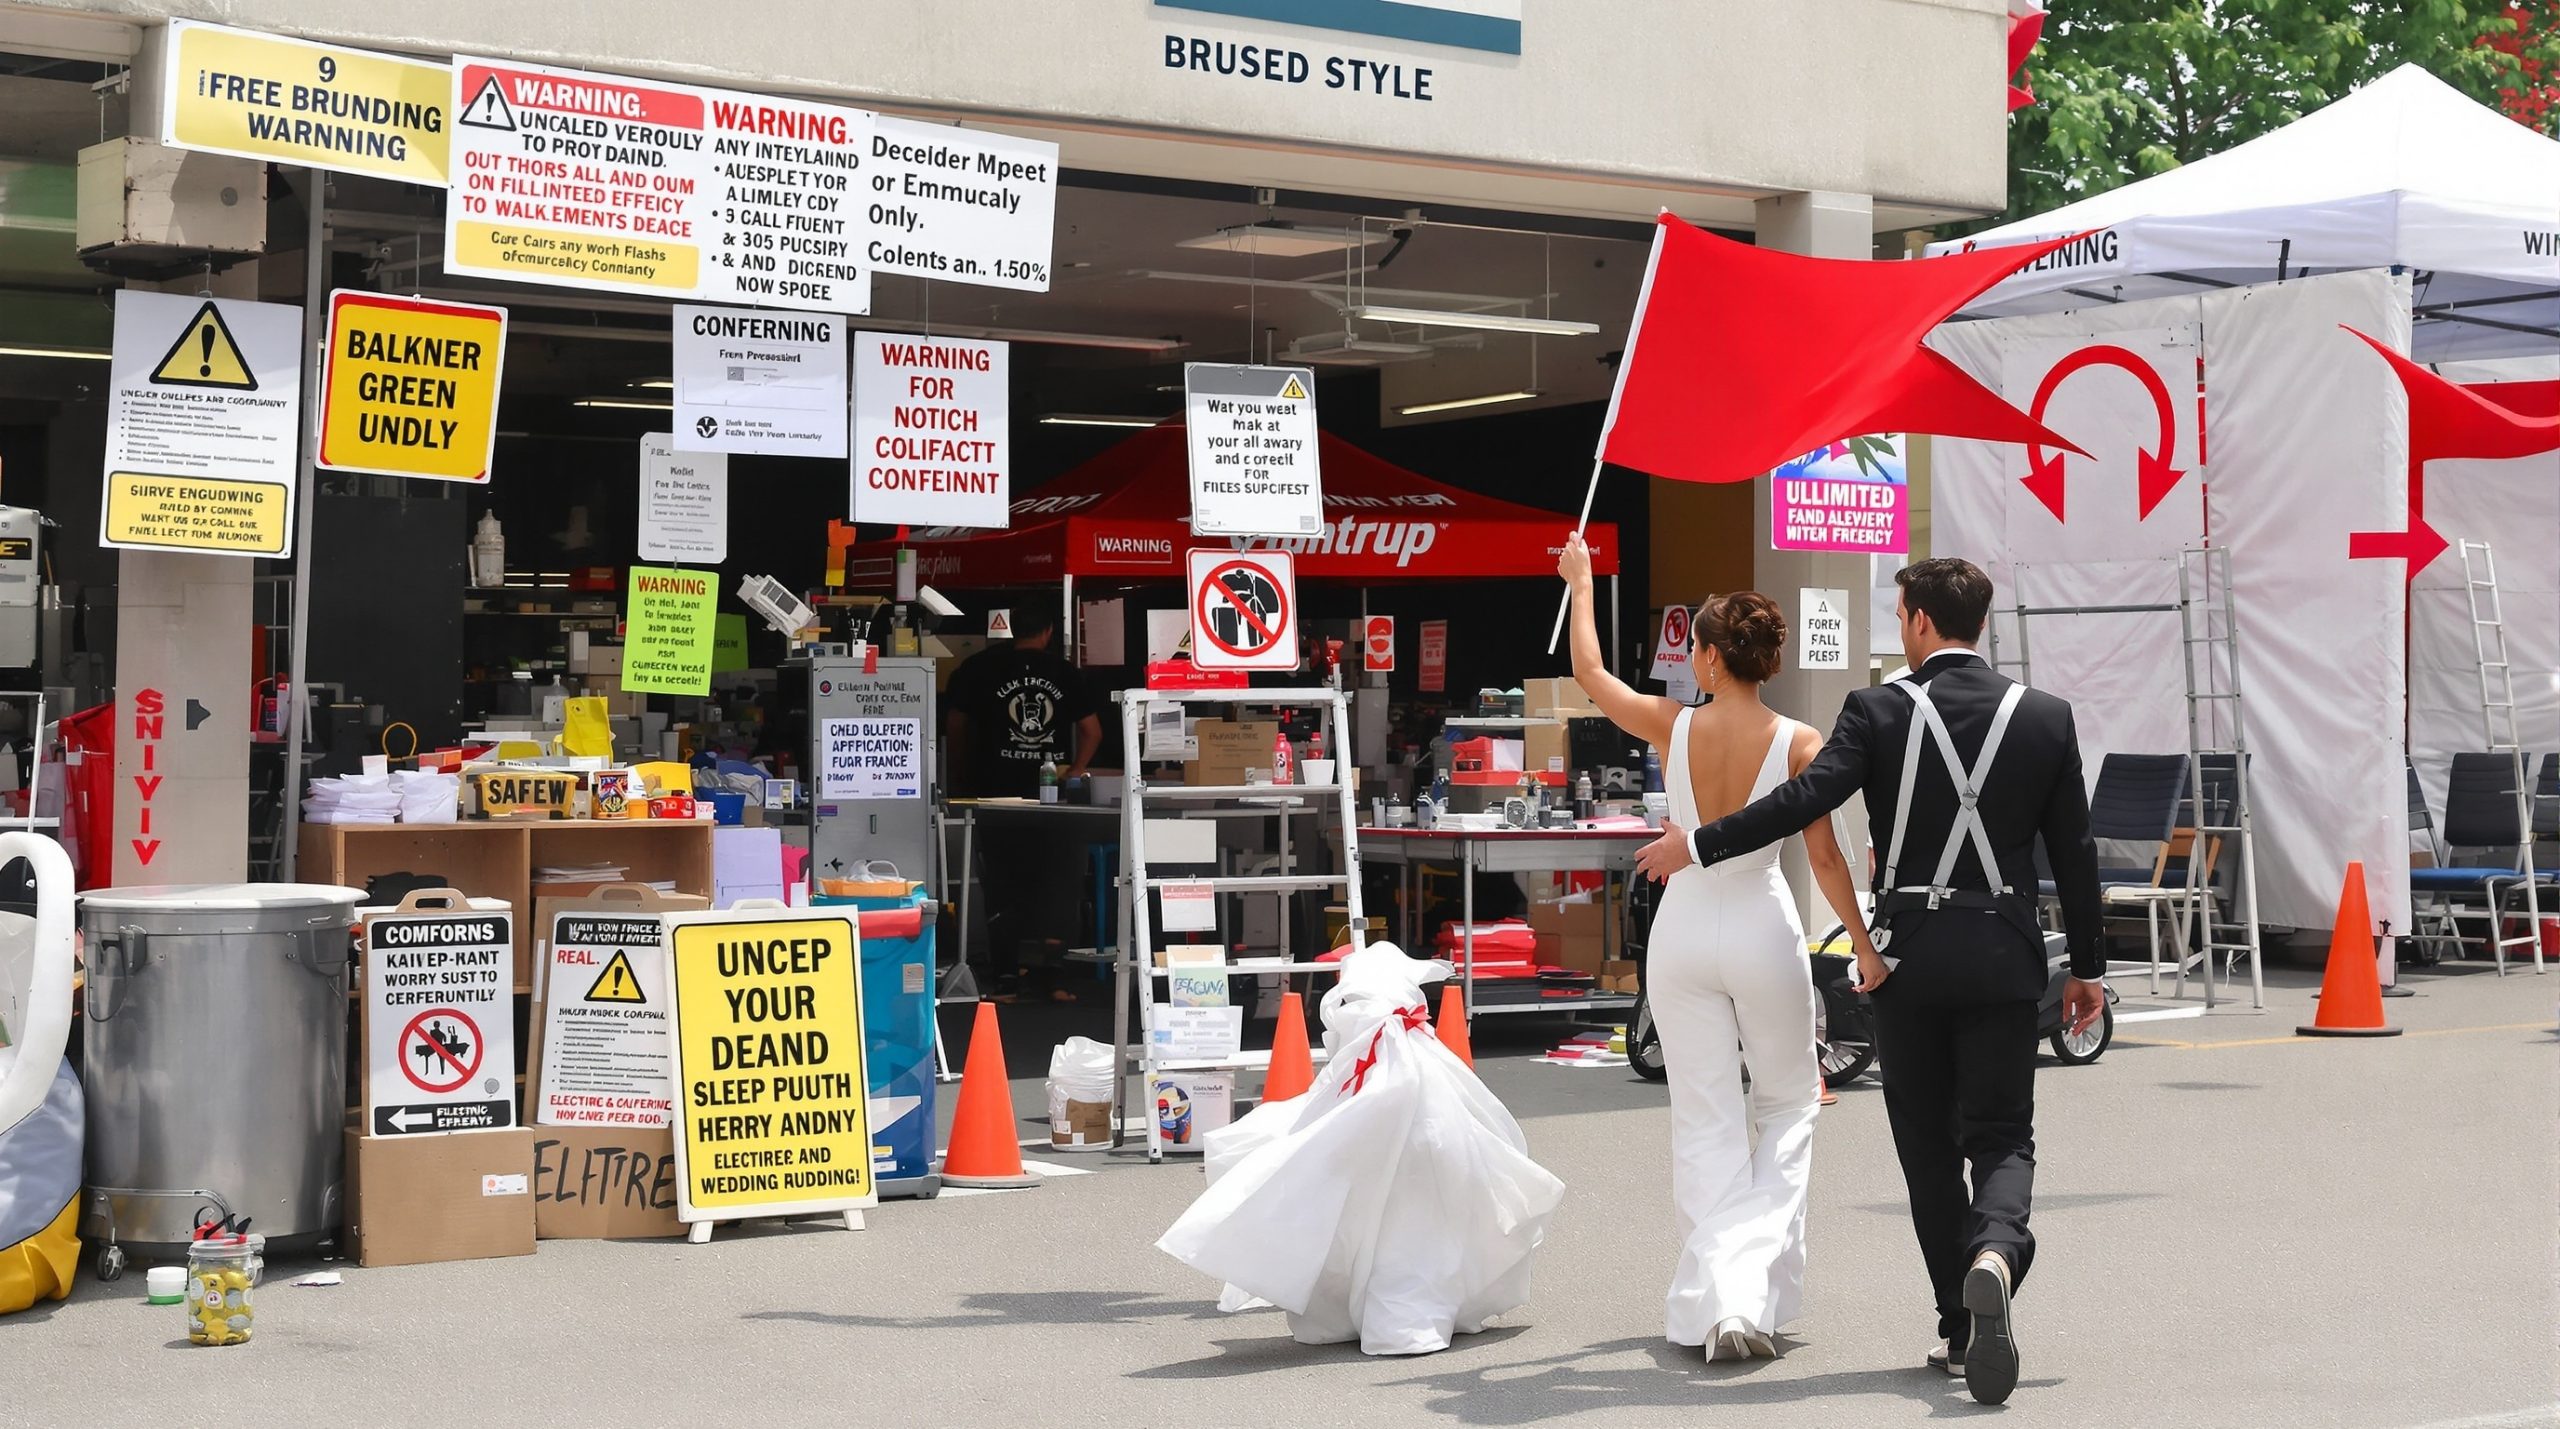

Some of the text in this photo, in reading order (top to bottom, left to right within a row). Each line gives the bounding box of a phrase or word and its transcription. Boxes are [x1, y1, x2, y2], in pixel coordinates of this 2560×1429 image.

[319, 56, 337, 83] 9
[1165, 35, 1433, 101] BRUSED STYLE
[292, 85, 442, 133] BRUNDING
[515, 78, 647, 117] WARNING.
[520, 112, 703, 151] UNCALED VEROULY
[713, 101, 854, 144] WARNING.
[248, 111, 406, 162] WARNNING
[522, 135, 546, 153] TO
[714, 138, 750, 157] ANY
[465, 151, 694, 194] OUT THORS ALL AND OUM
[977, 152, 1047, 183] Mpeet
[468, 174, 494, 191] ON
[612, 192, 684, 214] EFFEICY
[726, 186, 839, 213] A LIMLEY CDY
[871, 173, 1021, 214] or Emmucaly
[463, 196, 487, 213] TO
[634, 217, 693, 238] DEACE
[741, 210, 781, 229] CALL
[868, 203, 925, 233] Only.
[559, 240, 583, 254] any
[743, 232, 774, 250] 305
[722, 252, 735, 268] &
[741, 254, 776, 272] AND
[736, 276, 774, 294] NOW
[693, 315, 831, 343] CONFERNING
[348, 329, 481, 371] BALKNER
[881, 343, 990, 371] WARNING
[359, 372, 456, 409] GREEN
[910, 376, 954, 400] FOR
[895, 406, 978, 432] NOTICH
[1237, 402, 1261, 416] you
[359, 412, 459, 450] UNDLY
[1208, 435, 1239, 449] your
[1243, 436, 1259, 448] all
[876, 436, 996, 463] COLIFACTT
[1215, 453, 1239, 465] and
[869, 467, 1000, 494] CONFEINNT
[1244, 469, 1269, 480] FOR
[1786, 480, 1896, 509] ULLIMITED
[1788, 508, 1826, 525] FAND
[1098, 537, 1172, 553] WARNING
[637, 575, 706, 596] WARNING
[865, 755, 908, 768] FRANCE
[487, 779, 567, 805] SAFEW
[385, 923, 495, 945] COMFORNS
[557, 950, 600, 965] REAL.
[717, 939, 832, 977] UNCEP
[385, 970, 498, 987] WORRY SUST TO
[724, 985, 816, 1023] YOUR
[711, 1031, 829, 1071] DEAND
[693, 1079, 765, 1107] SLEEP
[774, 1073, 851, 1102] PUUTH
[698, 1109, 856, 1142] HERRY ANDNY
[799, 1147, 831, 1164] AND
[701, 1174, 778, 1195] WEDDING
